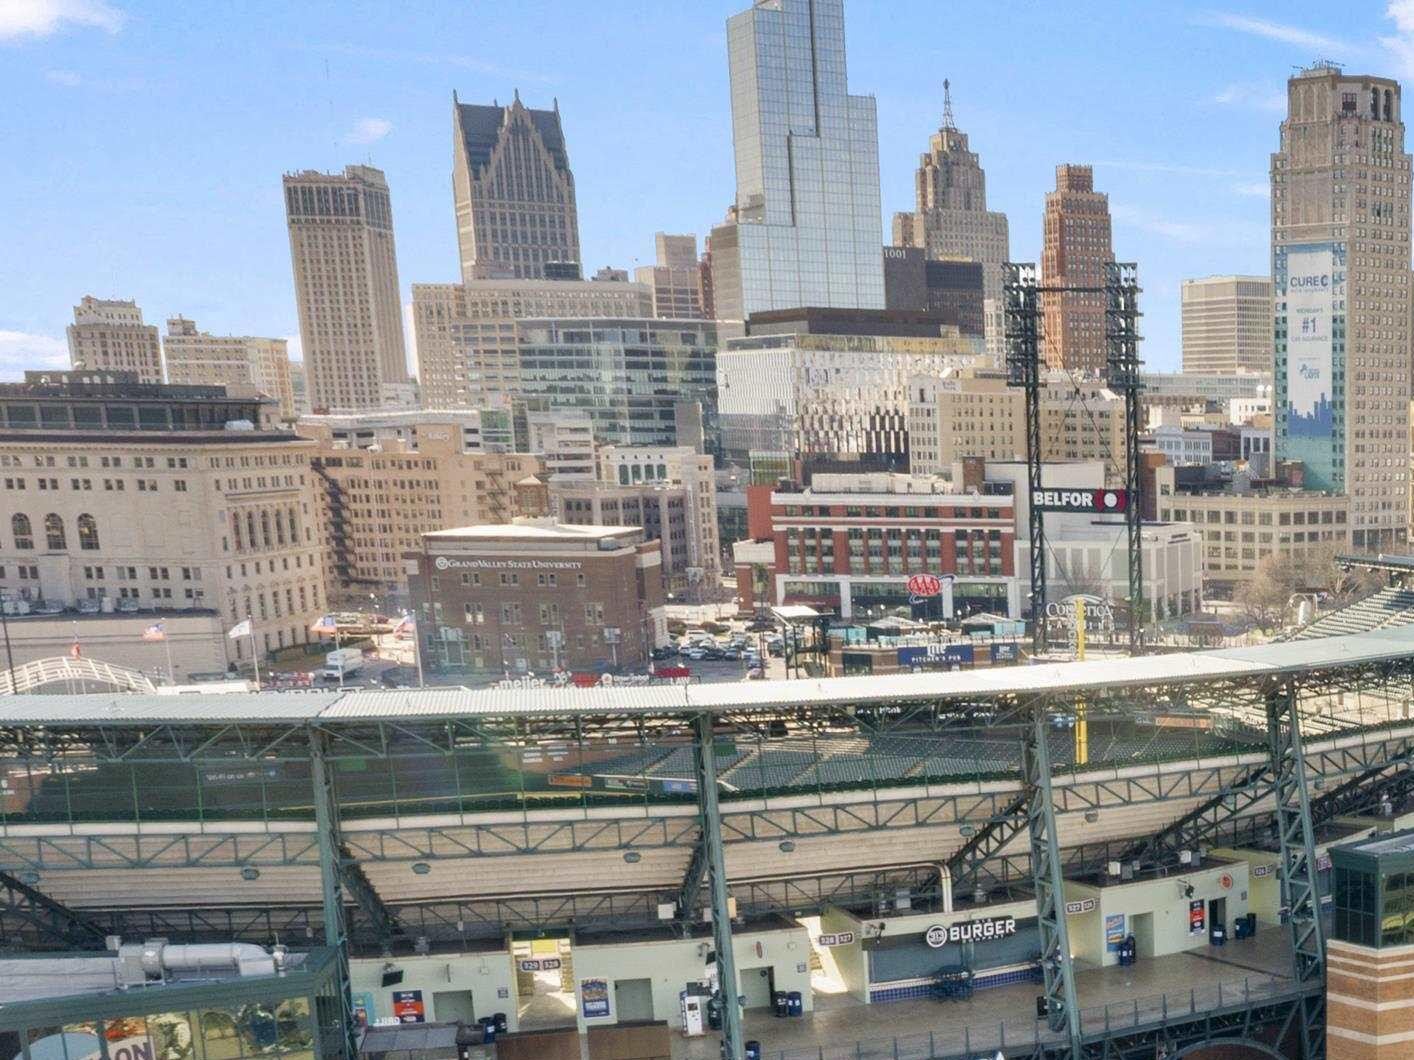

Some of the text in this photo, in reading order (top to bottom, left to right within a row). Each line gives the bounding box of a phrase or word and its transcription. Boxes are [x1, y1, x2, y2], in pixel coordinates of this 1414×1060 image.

[1302, 317, 1317, 332] #1
[1033, 491, 1093, 507] BELFOR
[449, 559, 582, 569] GRAND VALLEY STATE UNIVERSITY
[908, 575, 940, 595] AAA
[950, 919, 1016, 941] BURGER
